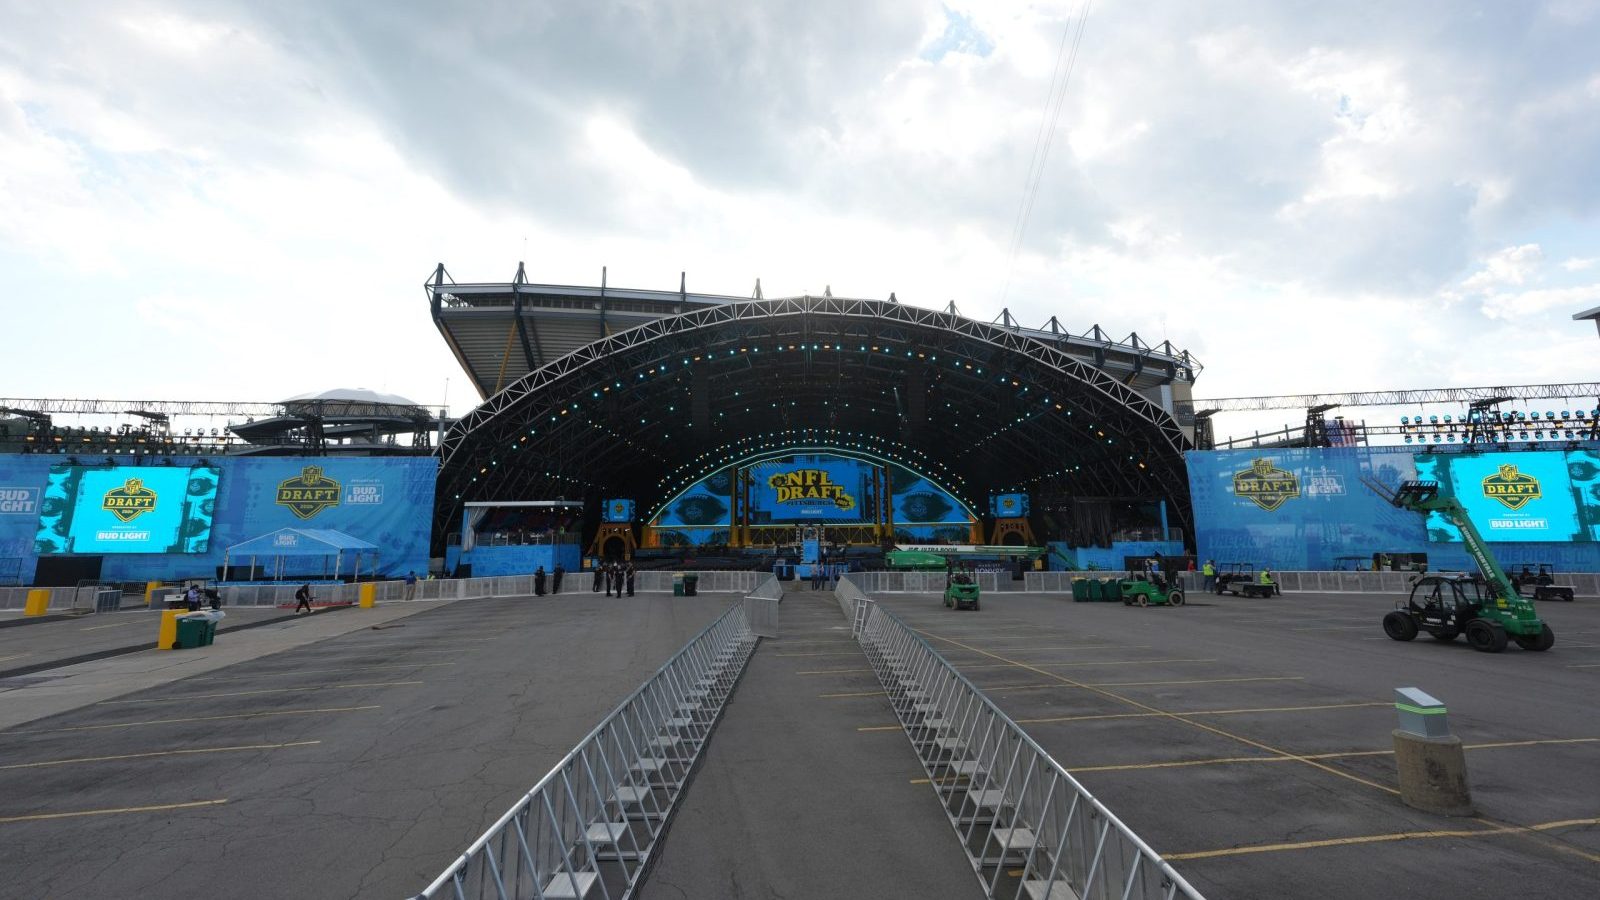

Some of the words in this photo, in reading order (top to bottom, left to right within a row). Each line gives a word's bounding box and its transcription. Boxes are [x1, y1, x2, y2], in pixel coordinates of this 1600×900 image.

[785, 469, 833, 486] NFL
[352, 486, 377, 495] BUD
[1239, 481, 1293, 492] DRAFT
[1487, 484, 1535, 494] DRAFT
[281, 490, 335, 500] DRAFT
[347, 494, 381, 502] LIGHT
[777, 486, 843, 504] DRAFT
[107, 498, 152, 506] DRAFT
[1491, 520, 1513, 528] BUD
[1514, 520, 1546, 528] LIGHT
[98, 532, 118, 540] BUD
[119, 532, 148, 540] LIGHT
